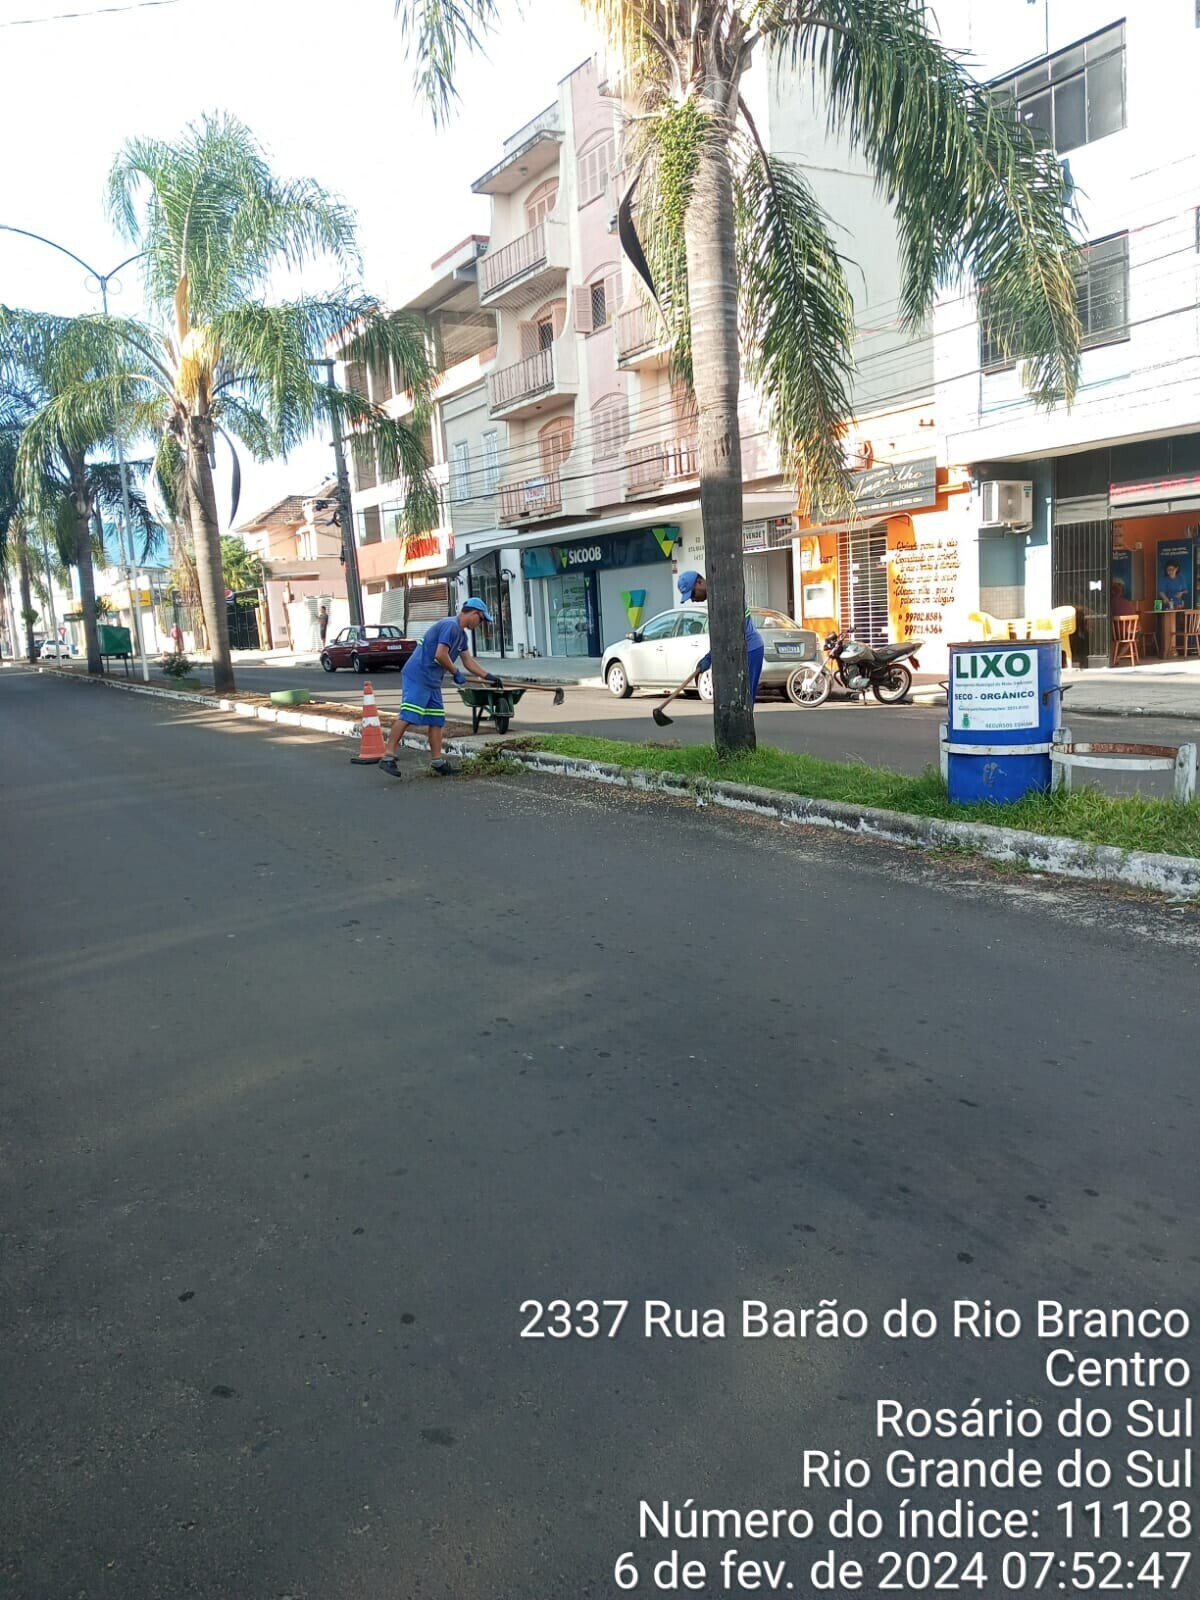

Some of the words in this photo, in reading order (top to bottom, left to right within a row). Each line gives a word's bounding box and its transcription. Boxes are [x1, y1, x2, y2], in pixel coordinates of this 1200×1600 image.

[568, 545, 602, 565] SICOOB
[956, 652, 1031, 679] LIXO
[955, 693, 973, 701] SECO
